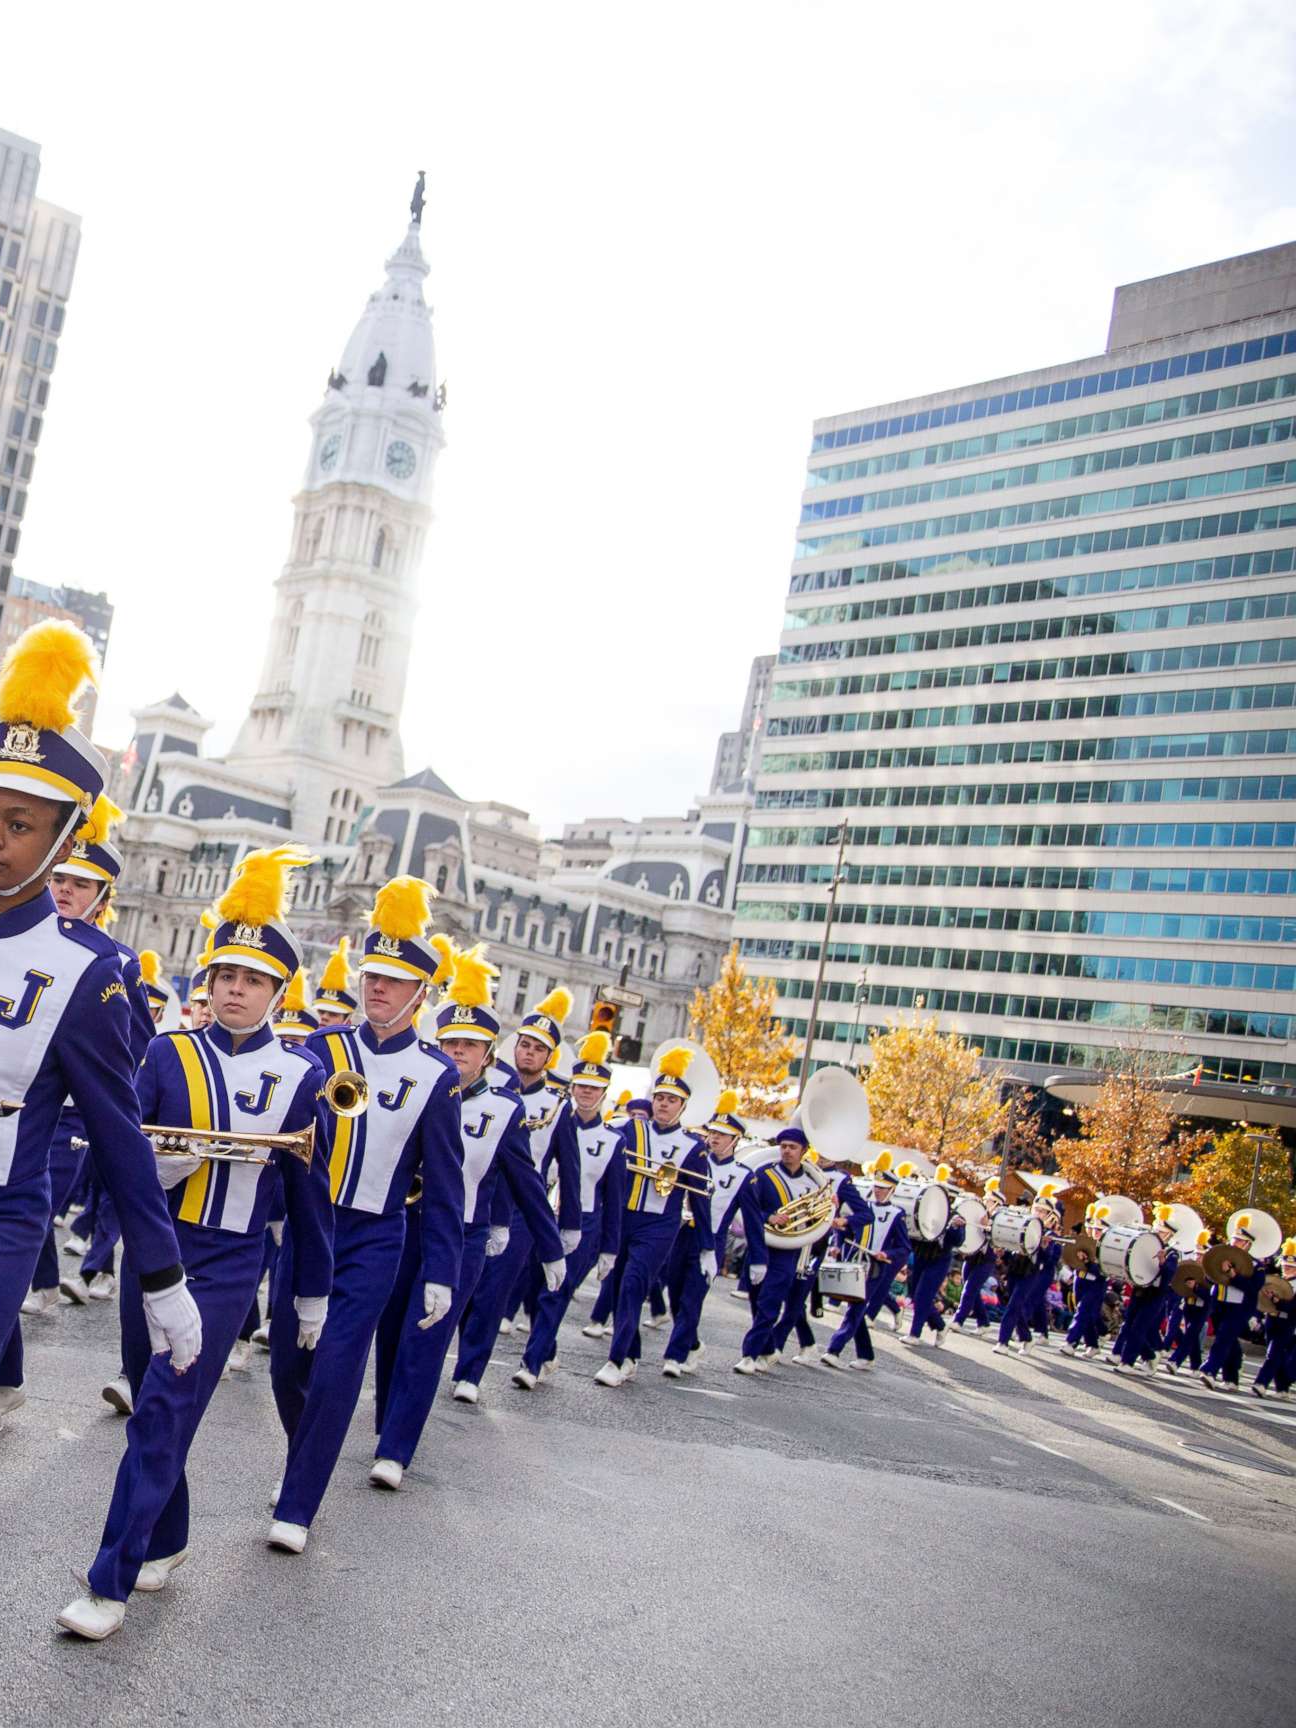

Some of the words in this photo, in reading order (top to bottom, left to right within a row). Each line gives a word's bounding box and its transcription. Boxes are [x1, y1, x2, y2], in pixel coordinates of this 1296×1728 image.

[234, 1070, 282, 1116] J
[377, 1075, 417, 1111] J
[463, 1112, 495, 1139] J
[586, 1140, 606, 1157] J
[661, 1145, 680, 1160] J
[719, 1174, 736, 1189] J
[878, 1211, 891, 1223] J
